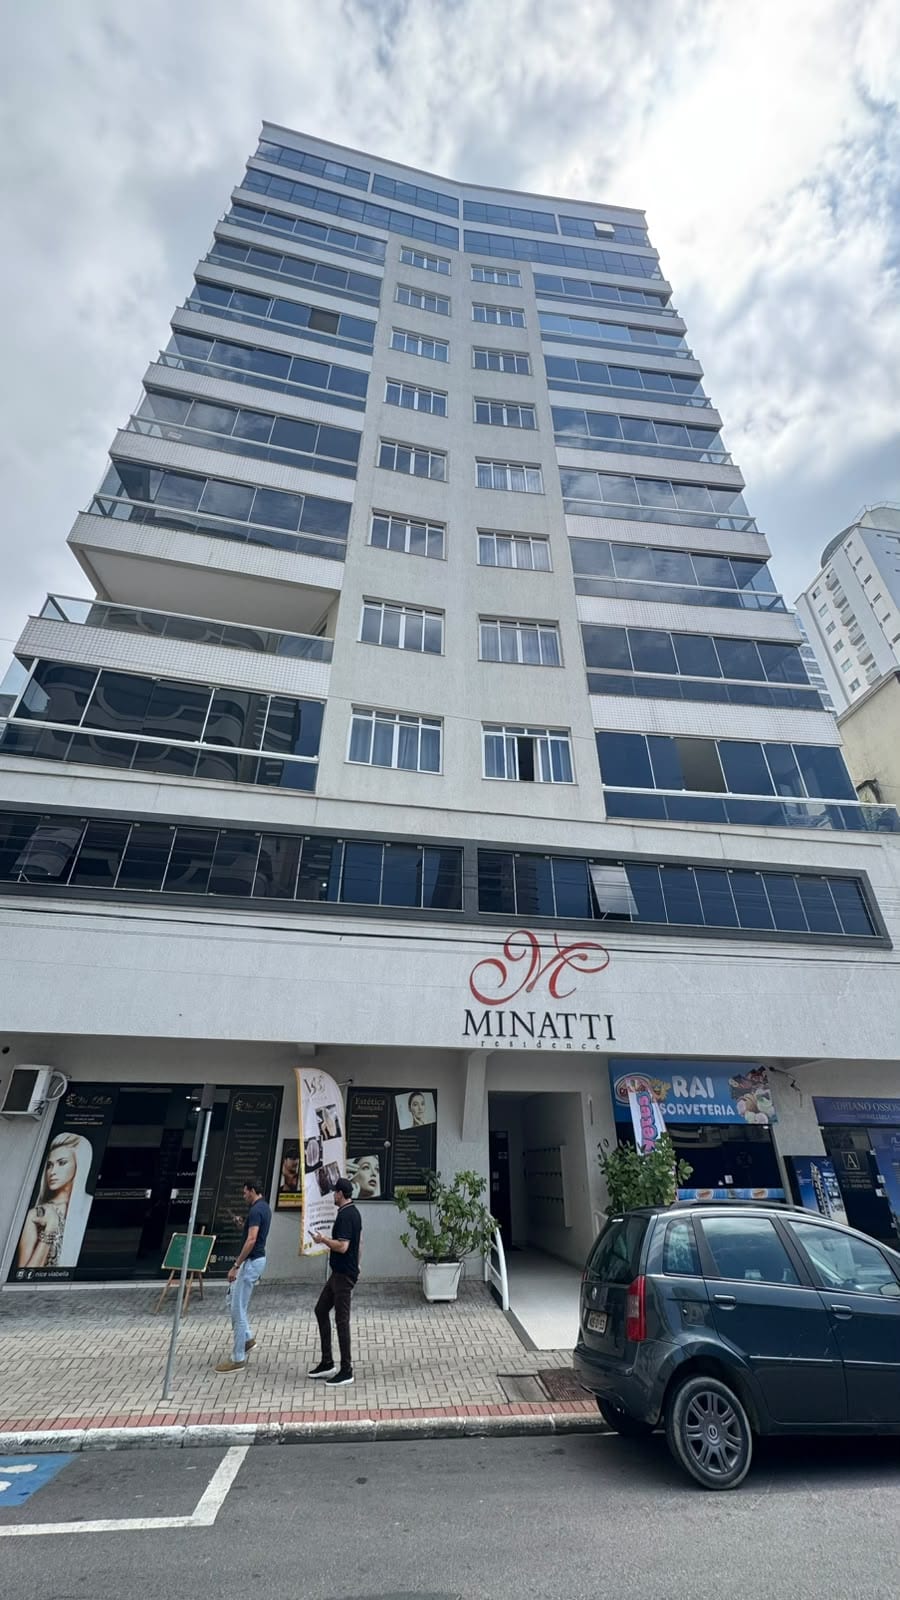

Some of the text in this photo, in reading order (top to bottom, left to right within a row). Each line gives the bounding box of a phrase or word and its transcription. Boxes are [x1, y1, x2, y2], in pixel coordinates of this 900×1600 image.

[461, 1008, 617, 1041] MINATTI
[480, 1039, 601, 1050] residence
[671, 1075, 716, 1099] RAI
[660, 1103, 736, 1117] SORVETERIA
